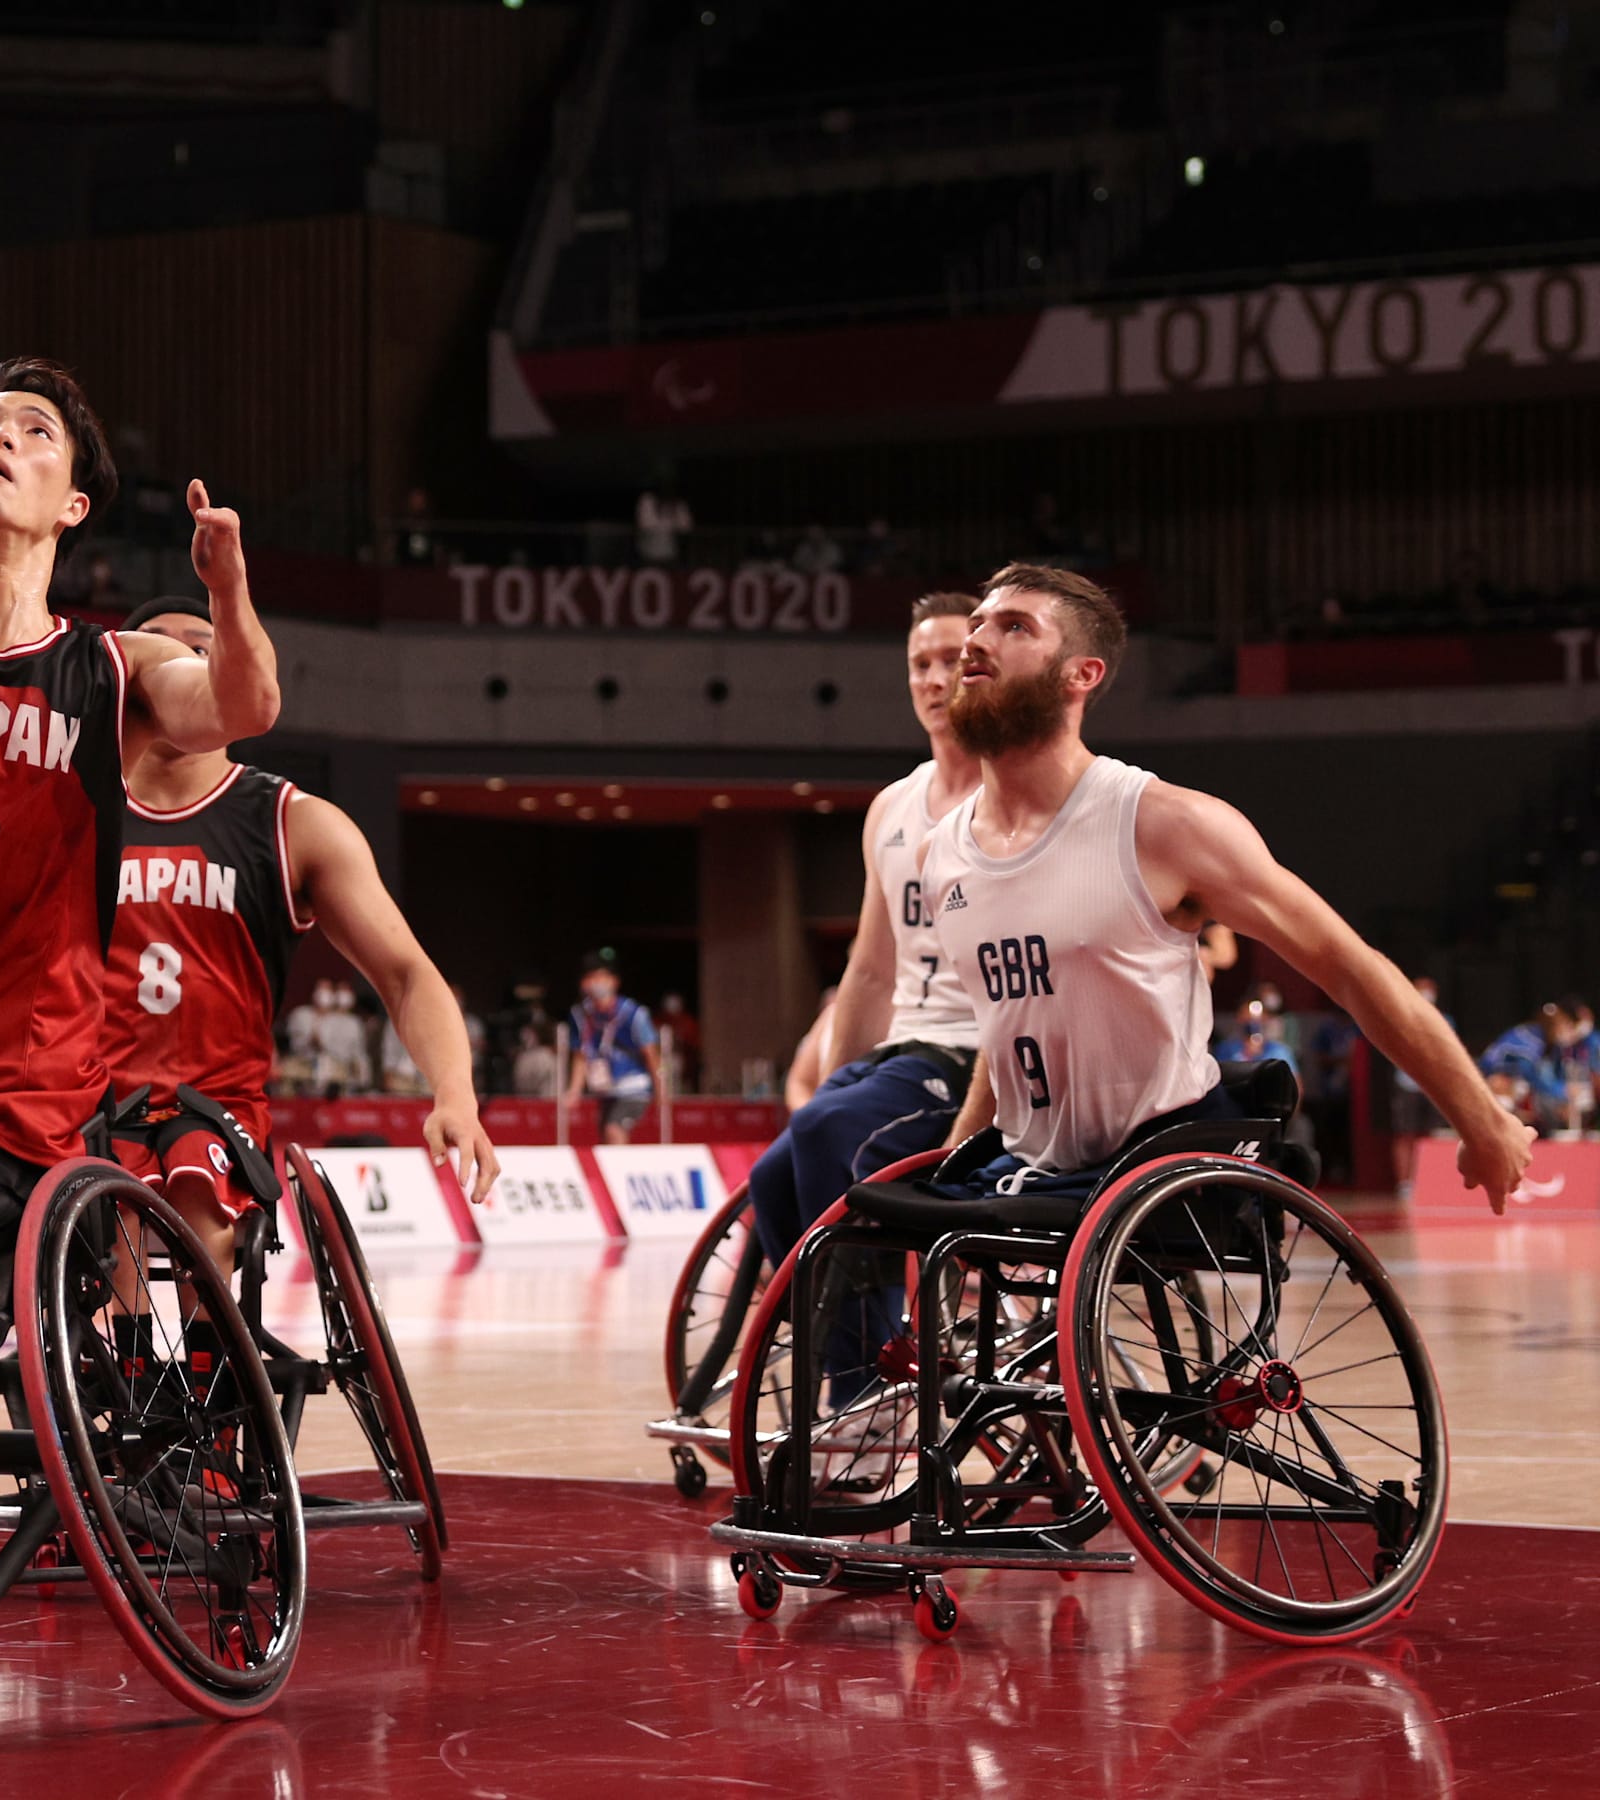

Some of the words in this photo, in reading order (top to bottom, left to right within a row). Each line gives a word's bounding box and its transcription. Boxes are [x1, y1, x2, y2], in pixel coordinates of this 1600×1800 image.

[1089, 283, 1424, 396] TOKYO
[448, 565, 673, 629] TOKYO
[688, 567, 852, 631] 2020
[117, 857, 237, 915] APAN
[903, 881, 933, 928] G
[137, 942, 182, 1015] 8
[919, 956, 938, 1009] 7
[977, 934, 1055, 1002] GBR
[1014, 1035, 1051, 1110] 9
